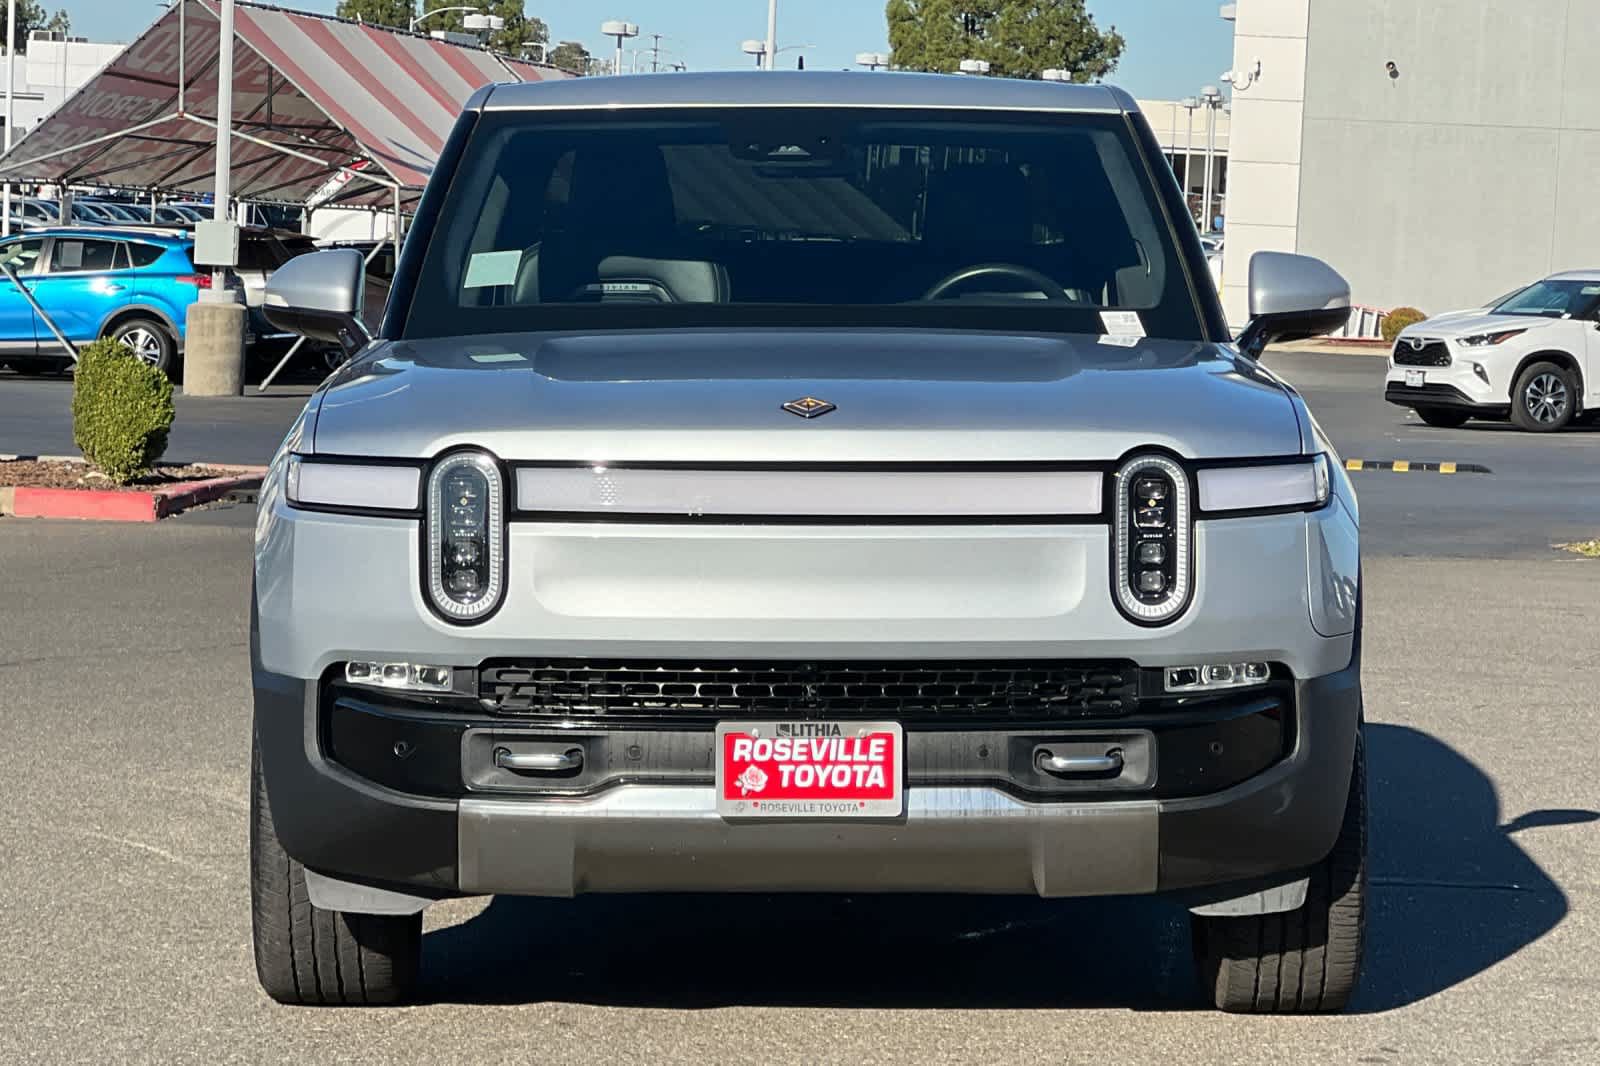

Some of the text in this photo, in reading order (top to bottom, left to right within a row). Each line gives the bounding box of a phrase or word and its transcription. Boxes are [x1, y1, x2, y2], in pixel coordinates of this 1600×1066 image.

[792, 723, 842, 737] LITHIA
[733, 738, 887, 762] ROSEVILLE
[778, 764, 886, 788] TOYOTA
[760, 802, 858, 813] ROSEVILLE TOYOTA
